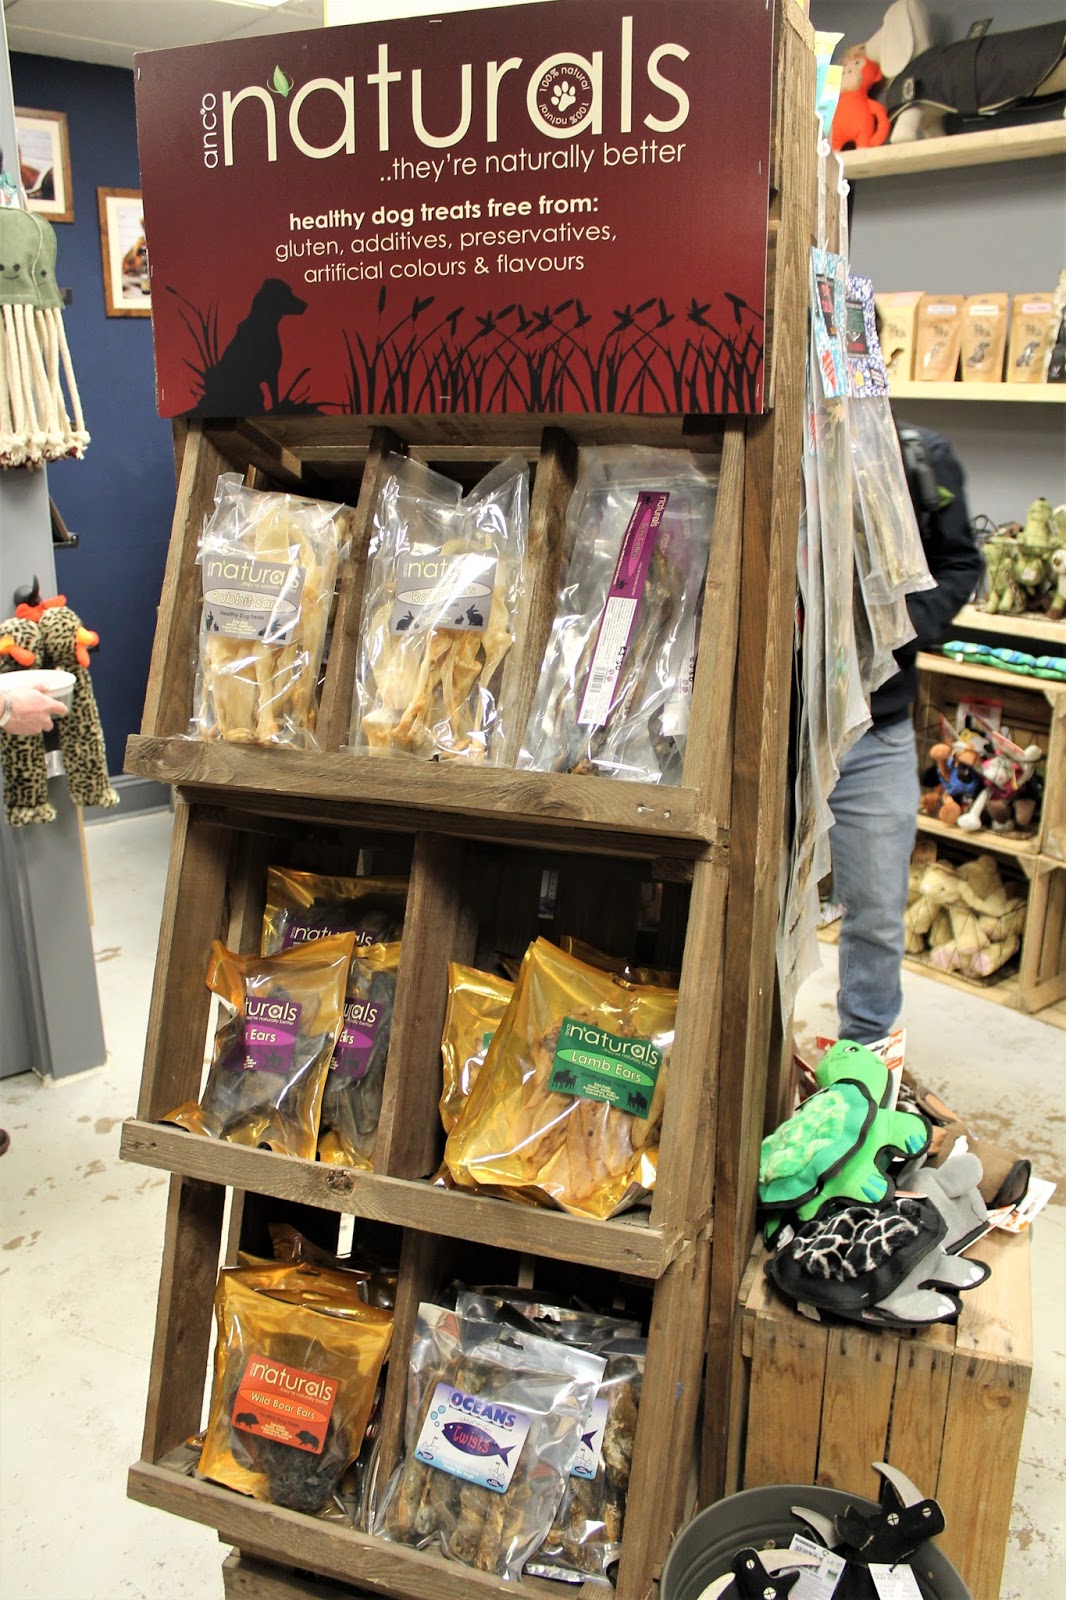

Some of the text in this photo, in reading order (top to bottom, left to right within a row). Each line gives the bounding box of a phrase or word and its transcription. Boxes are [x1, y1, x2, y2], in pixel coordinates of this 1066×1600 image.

[222, 16, 690, 166] naturals
[539, 67, 590, 92] 100% natural
[539, 102, 589, 124] 100% natural
[200, 93, 218, 168] anco
[486, 144, 594, 173] naturally
[604, 140, 686, 165] better
[290, 195, 598, 230] healthy dog treats free from:
[276, 223, 616, 262] gluten, additives, preservatives,
[305, 254, 585, 282] artificial colours & flavours
[210, 561, 300, 588] naturas
[212, 591, 253, 607] Rabbit
[250, 1029, 276, 1043] Ears
[570, 1025, 659, 1065] naturals
[571, 1050, 641, 1082] Lamb Ears
[252, 1363, 332, 1401] naturals
[251, 1392, 271, 1406] Wild
[273, 1399, 294, 1412] Boar
[296, 1407, 315, 1420] Ears
[450, 1392, 517, 1429] OCEANS
[453, 1425, 490, 1453] Twists
